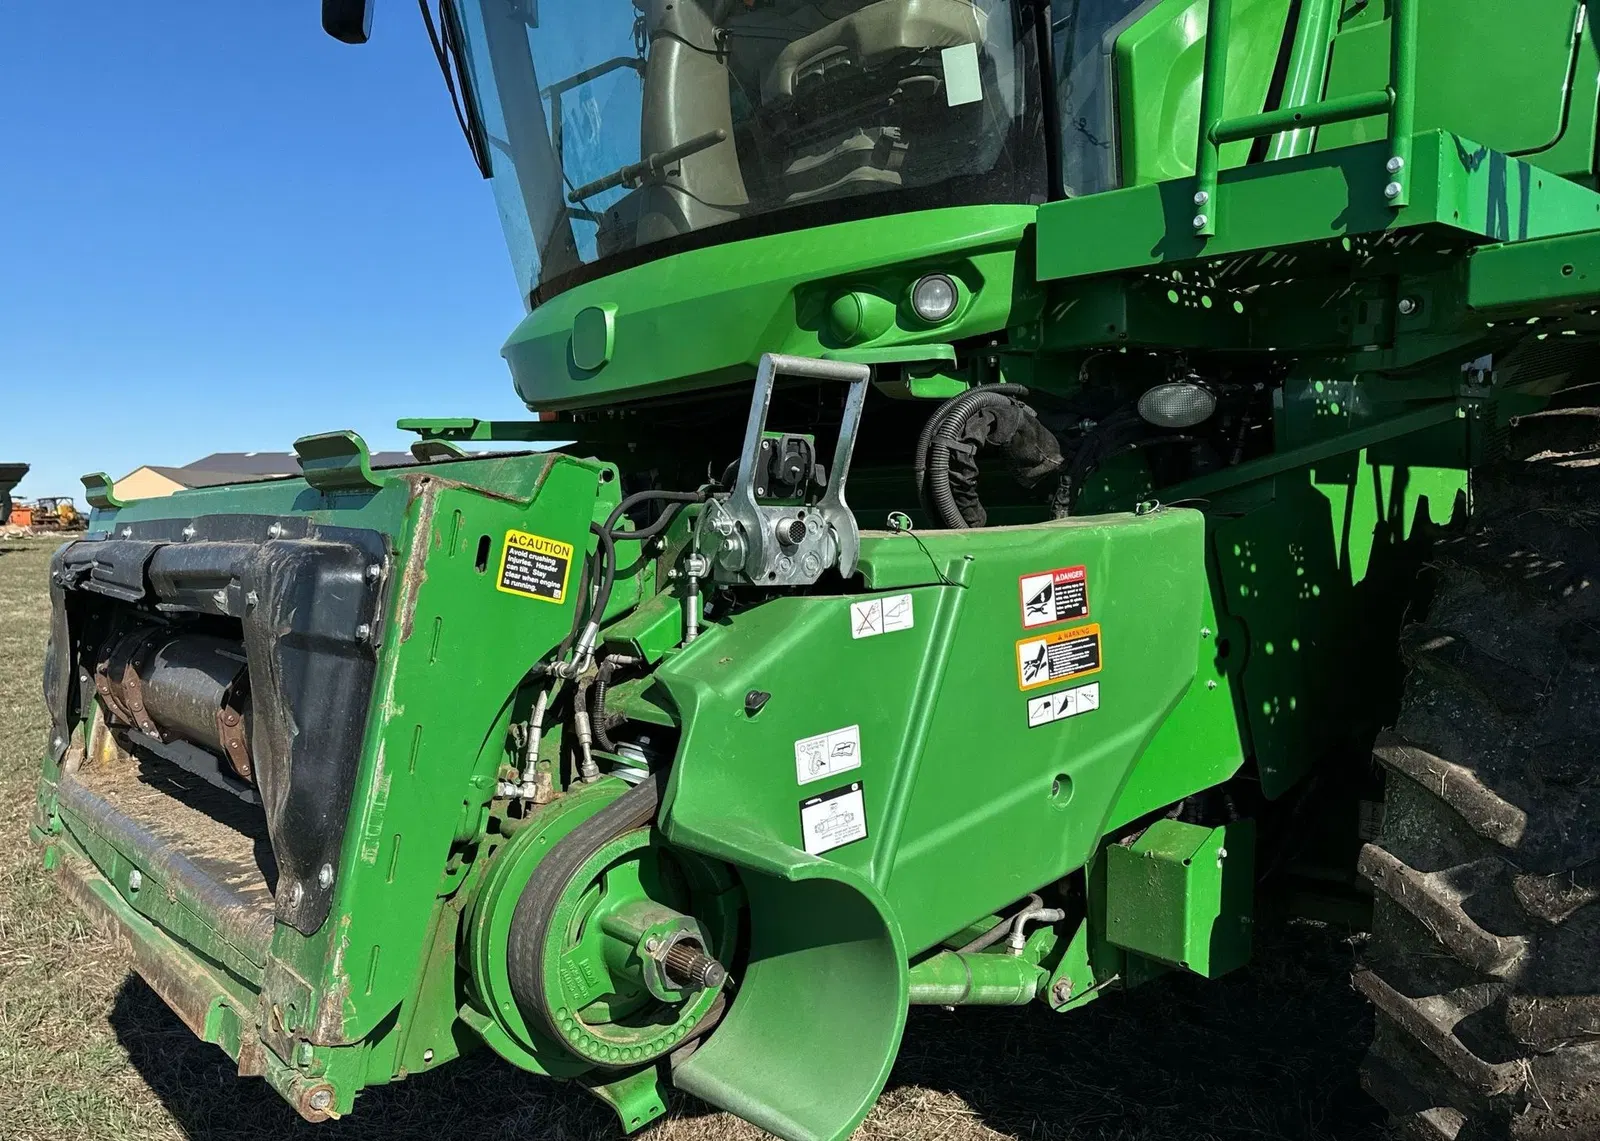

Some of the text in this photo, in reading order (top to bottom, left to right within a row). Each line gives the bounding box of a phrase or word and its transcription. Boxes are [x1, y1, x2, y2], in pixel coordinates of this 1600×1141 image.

[518, 535, 570, 557] CAUTION
[508, 547, 556, 566] Avoid crushing
[532, 568, 547, 579] Stay
[535, 562, 558, 573] Header
[505, 571, 561, 589] clear when engine
[1060, 570, 1084, 580] DANGER
[503, 577, 537, 592] is running.
[1064, 628, 1090, 639] WARNING
